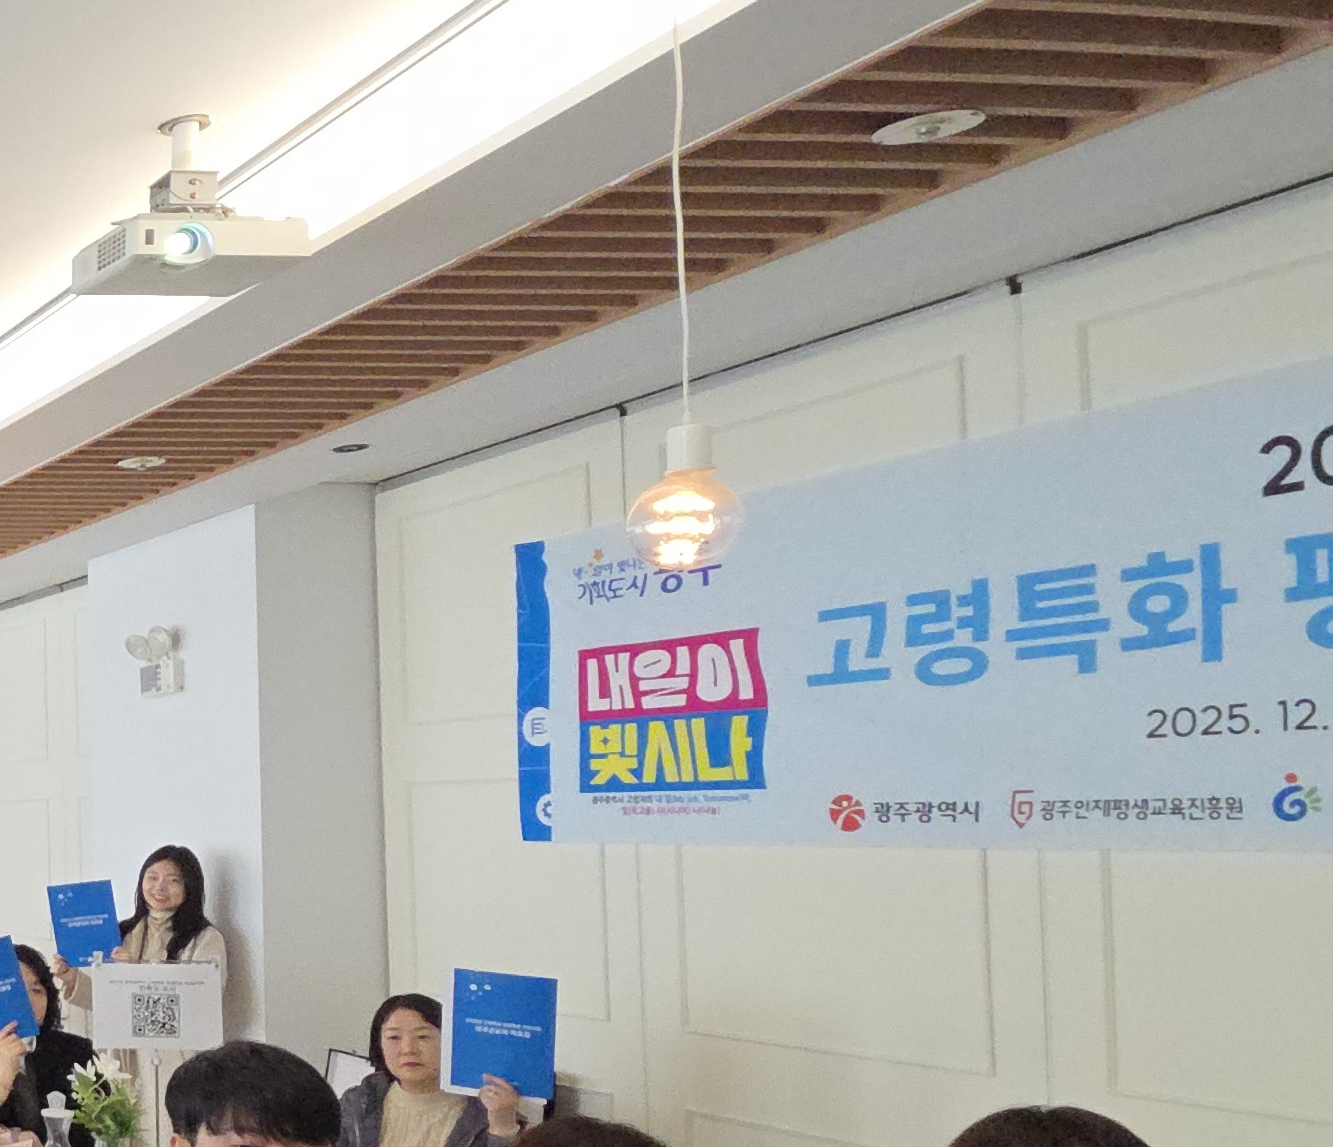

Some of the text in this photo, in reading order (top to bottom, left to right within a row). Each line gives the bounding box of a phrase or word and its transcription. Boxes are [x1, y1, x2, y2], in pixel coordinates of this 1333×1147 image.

[807, 542, 1237, 687] 고령특화
[587, 638, 754, 712] 내일이
[1146, 698, 1329, 739] 2025. 12.
[589, 715, 753, 785] 빛시나
[873, 800, 980, 824] 광주광역시
[1039, 796, 1244, 822] 광주인재평생교육진흥원
